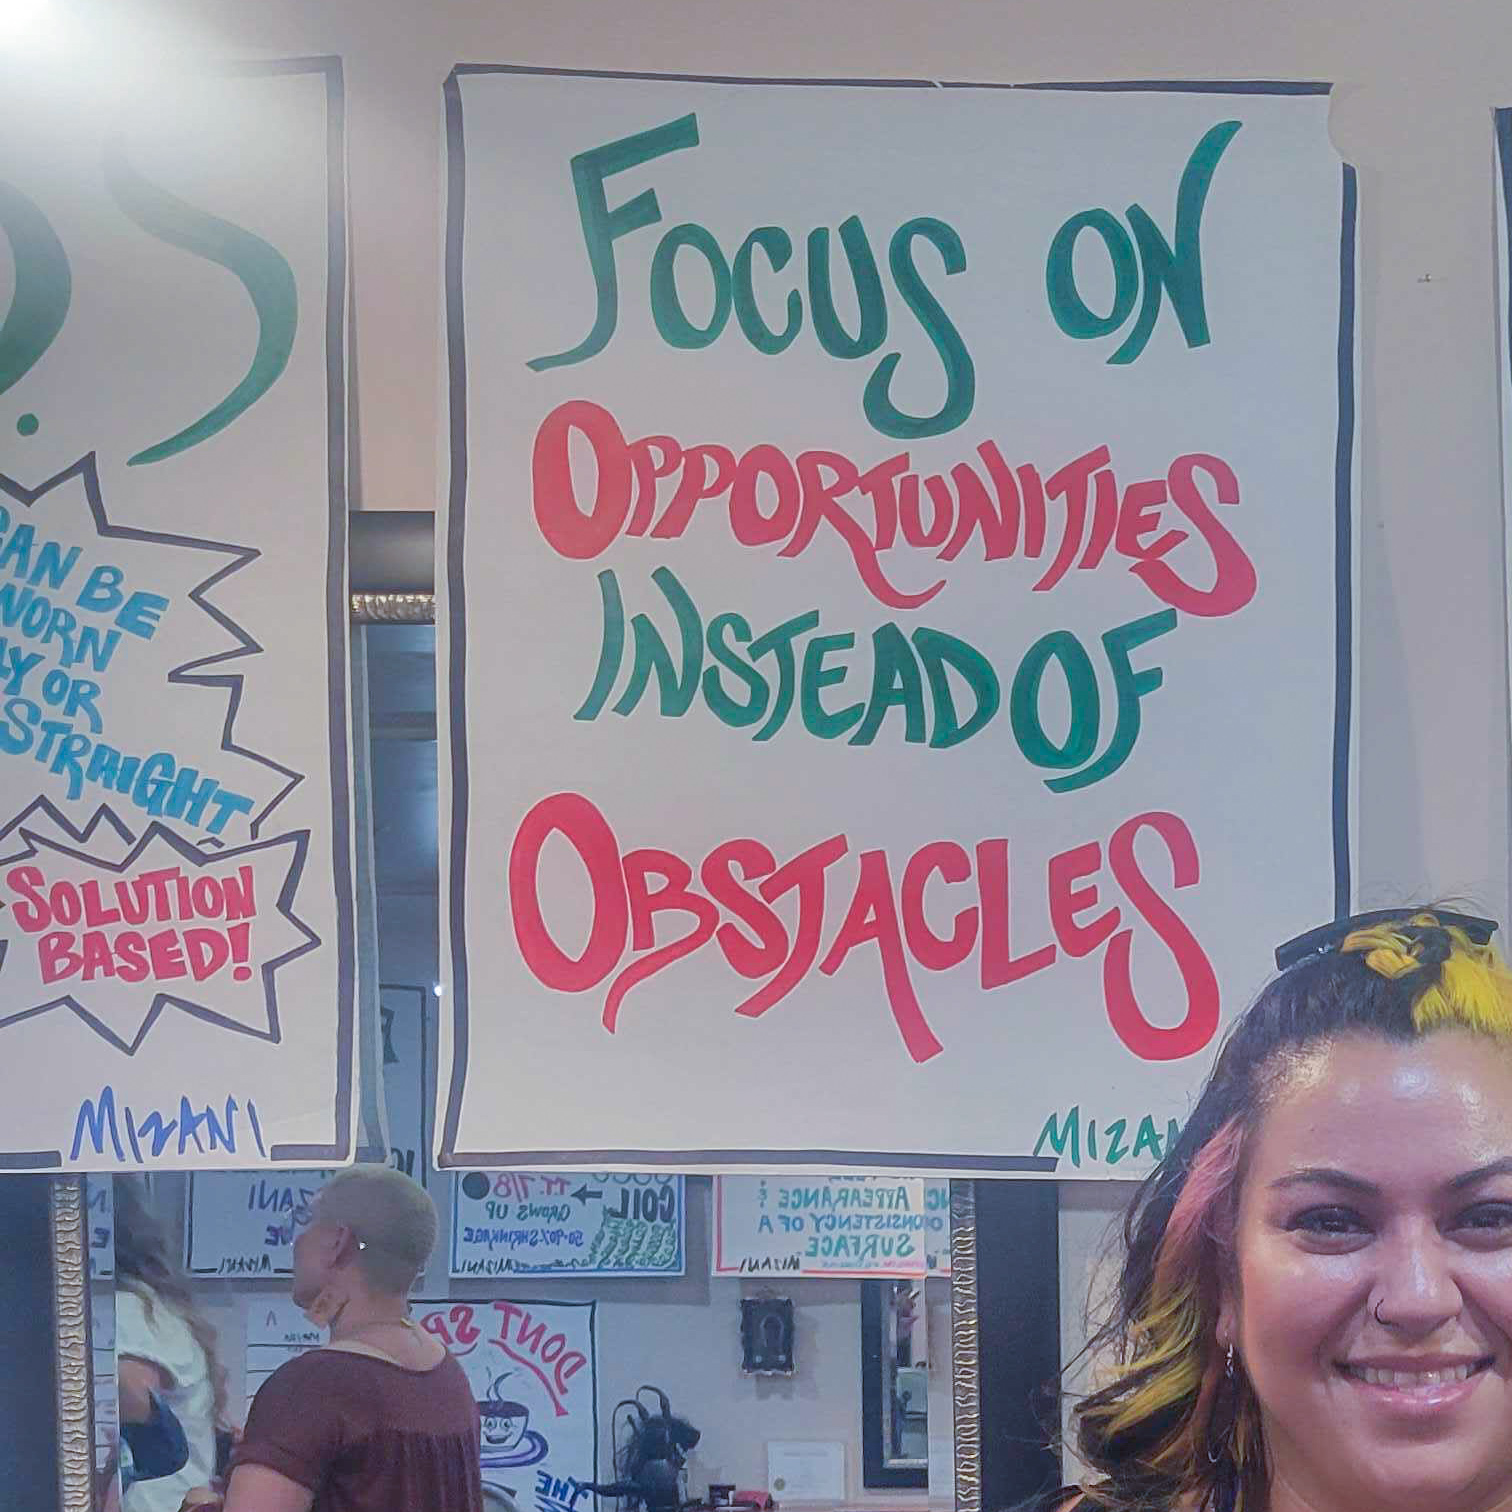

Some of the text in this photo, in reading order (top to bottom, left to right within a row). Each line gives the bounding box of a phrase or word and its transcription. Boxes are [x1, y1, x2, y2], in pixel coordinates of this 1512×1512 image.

[525, 112, 1243, 440] FOCUS ON
[532, 400, 1257, 617] OPPORTUNITIES
[76, 565, 170, 640] BE
[42, 669, 103, 734] OR
[573, 566, 1177, 793] INSTEAD OF
[0, 698, 255, 834] STRAIGHT
[6, 866, 257, 933] SOLUTION
[508, 791, 1221, 1063] OBSTACLES
[38, 922, 252, 984] BASED!
[70, 1086, 266, 1163] MIZANI
